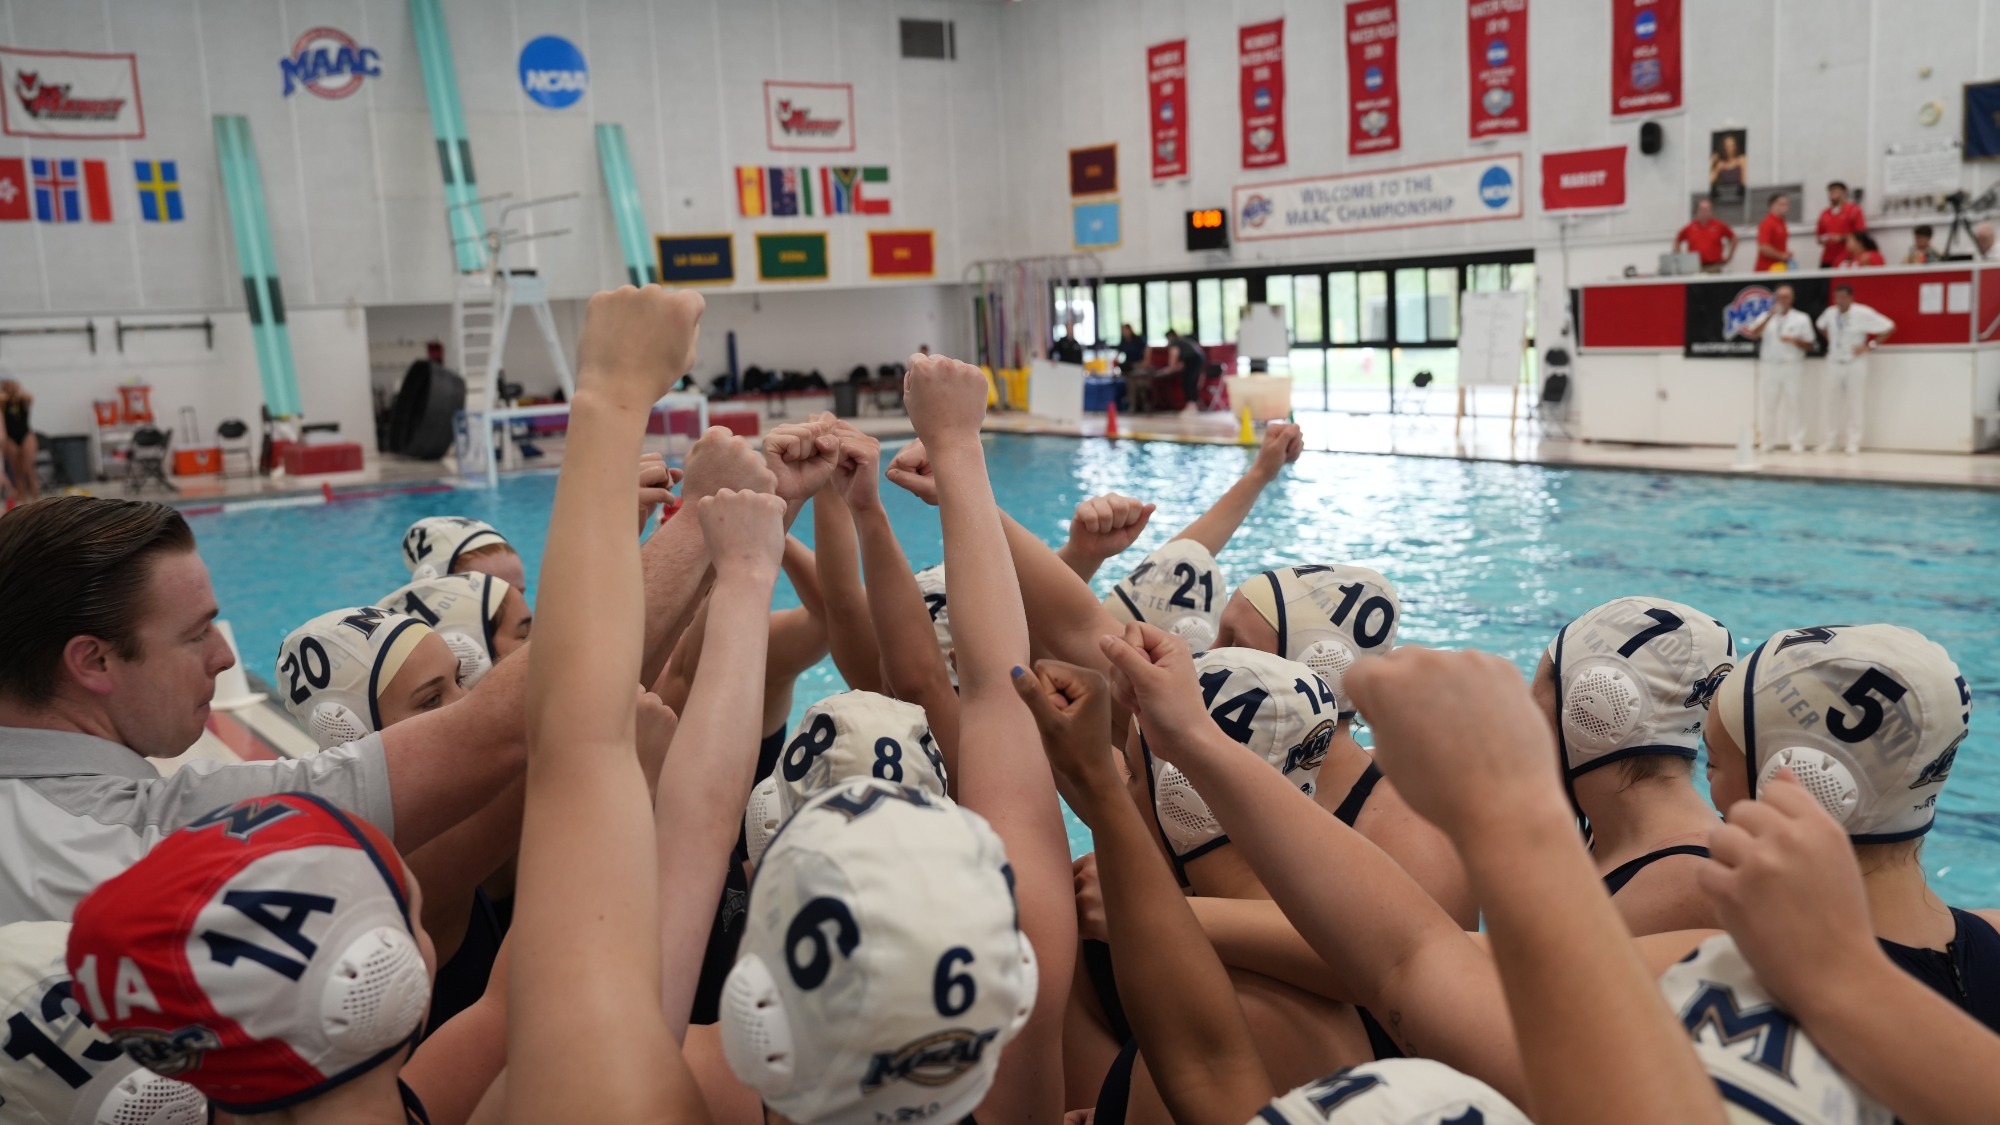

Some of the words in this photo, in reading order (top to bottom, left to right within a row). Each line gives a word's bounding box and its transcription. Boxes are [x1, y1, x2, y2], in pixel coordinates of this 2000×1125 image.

[280, 46, 382, 97] MAAC
[525, 69, 587, 92] NCAA
[1286, 206, 1332, 226] MAAC
[1337, 195, 1454, 223] CHAMPIONSHIP
[1302, 182, 1373, 204] WELCOME
[1380, 179, 1399, 197] TO
[1405, 175, 1433, 193] THE
[403, 527, 433, 565] 12
[1169, 562, 1213, 613] 21
[1329, 582, 1394, 648] 10
[1617, 608, 1684, 658] 7
[281, 636, 331, 706] 20
[1294, 673, 1336, 715] 14
[1199, 668, 1270, 744] 14
[1826, 667, 1907, 744] 5
[783, 713, 836, 782] 8
[873, 736, 904, 783] 8
[200, 889, 337, 982] 1A
[785, 896, 860, 991] 6
[75, 953, 163, 1023] 1A
[933, 946, 976, 1017] 6
[1676, 978, 1798, 1088] M
